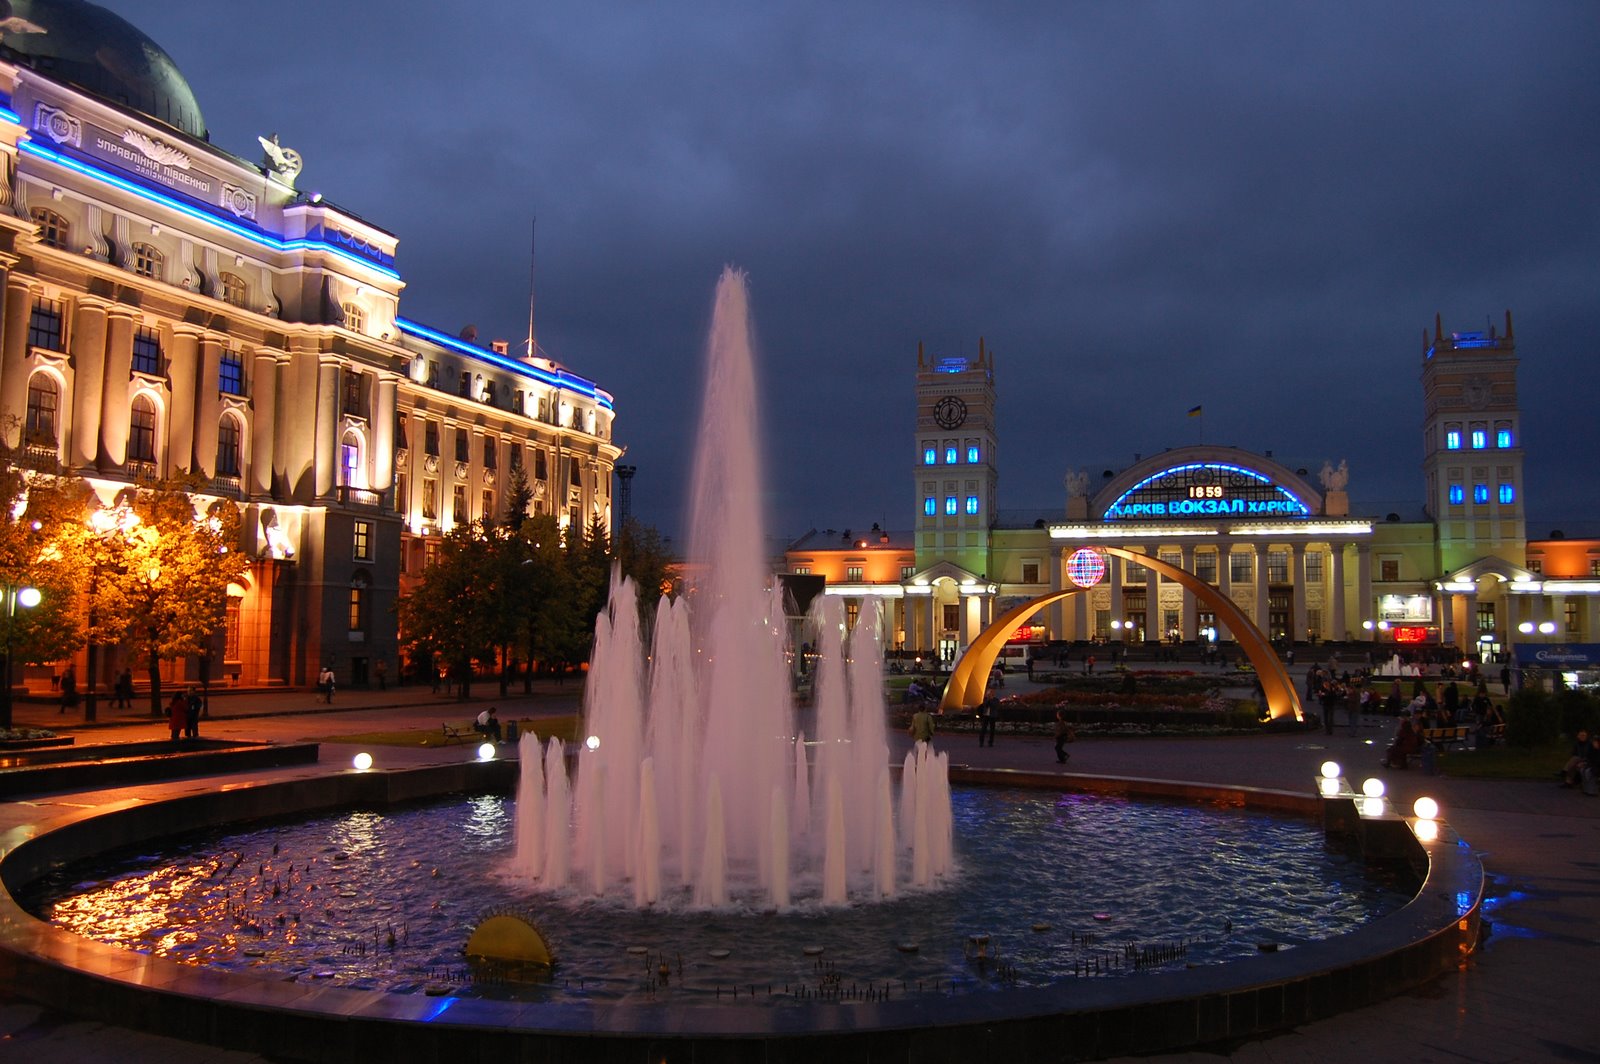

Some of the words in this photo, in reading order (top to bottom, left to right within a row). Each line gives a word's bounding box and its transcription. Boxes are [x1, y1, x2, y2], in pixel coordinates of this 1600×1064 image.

[96, 138, 160, 171] УПРАВЛІННЯ
[163, 167, 210, 193] ПІВДЕННОЇ
[135, 165, 175, 186] ЗАЛІЗНИЦІ
[1114, 503, 1165, 515] ХАРКІВ
[1168, 500, 1244, 514] ВОКЗАЛ
[1247, 501, 1300, 513] ХАРКІВ
